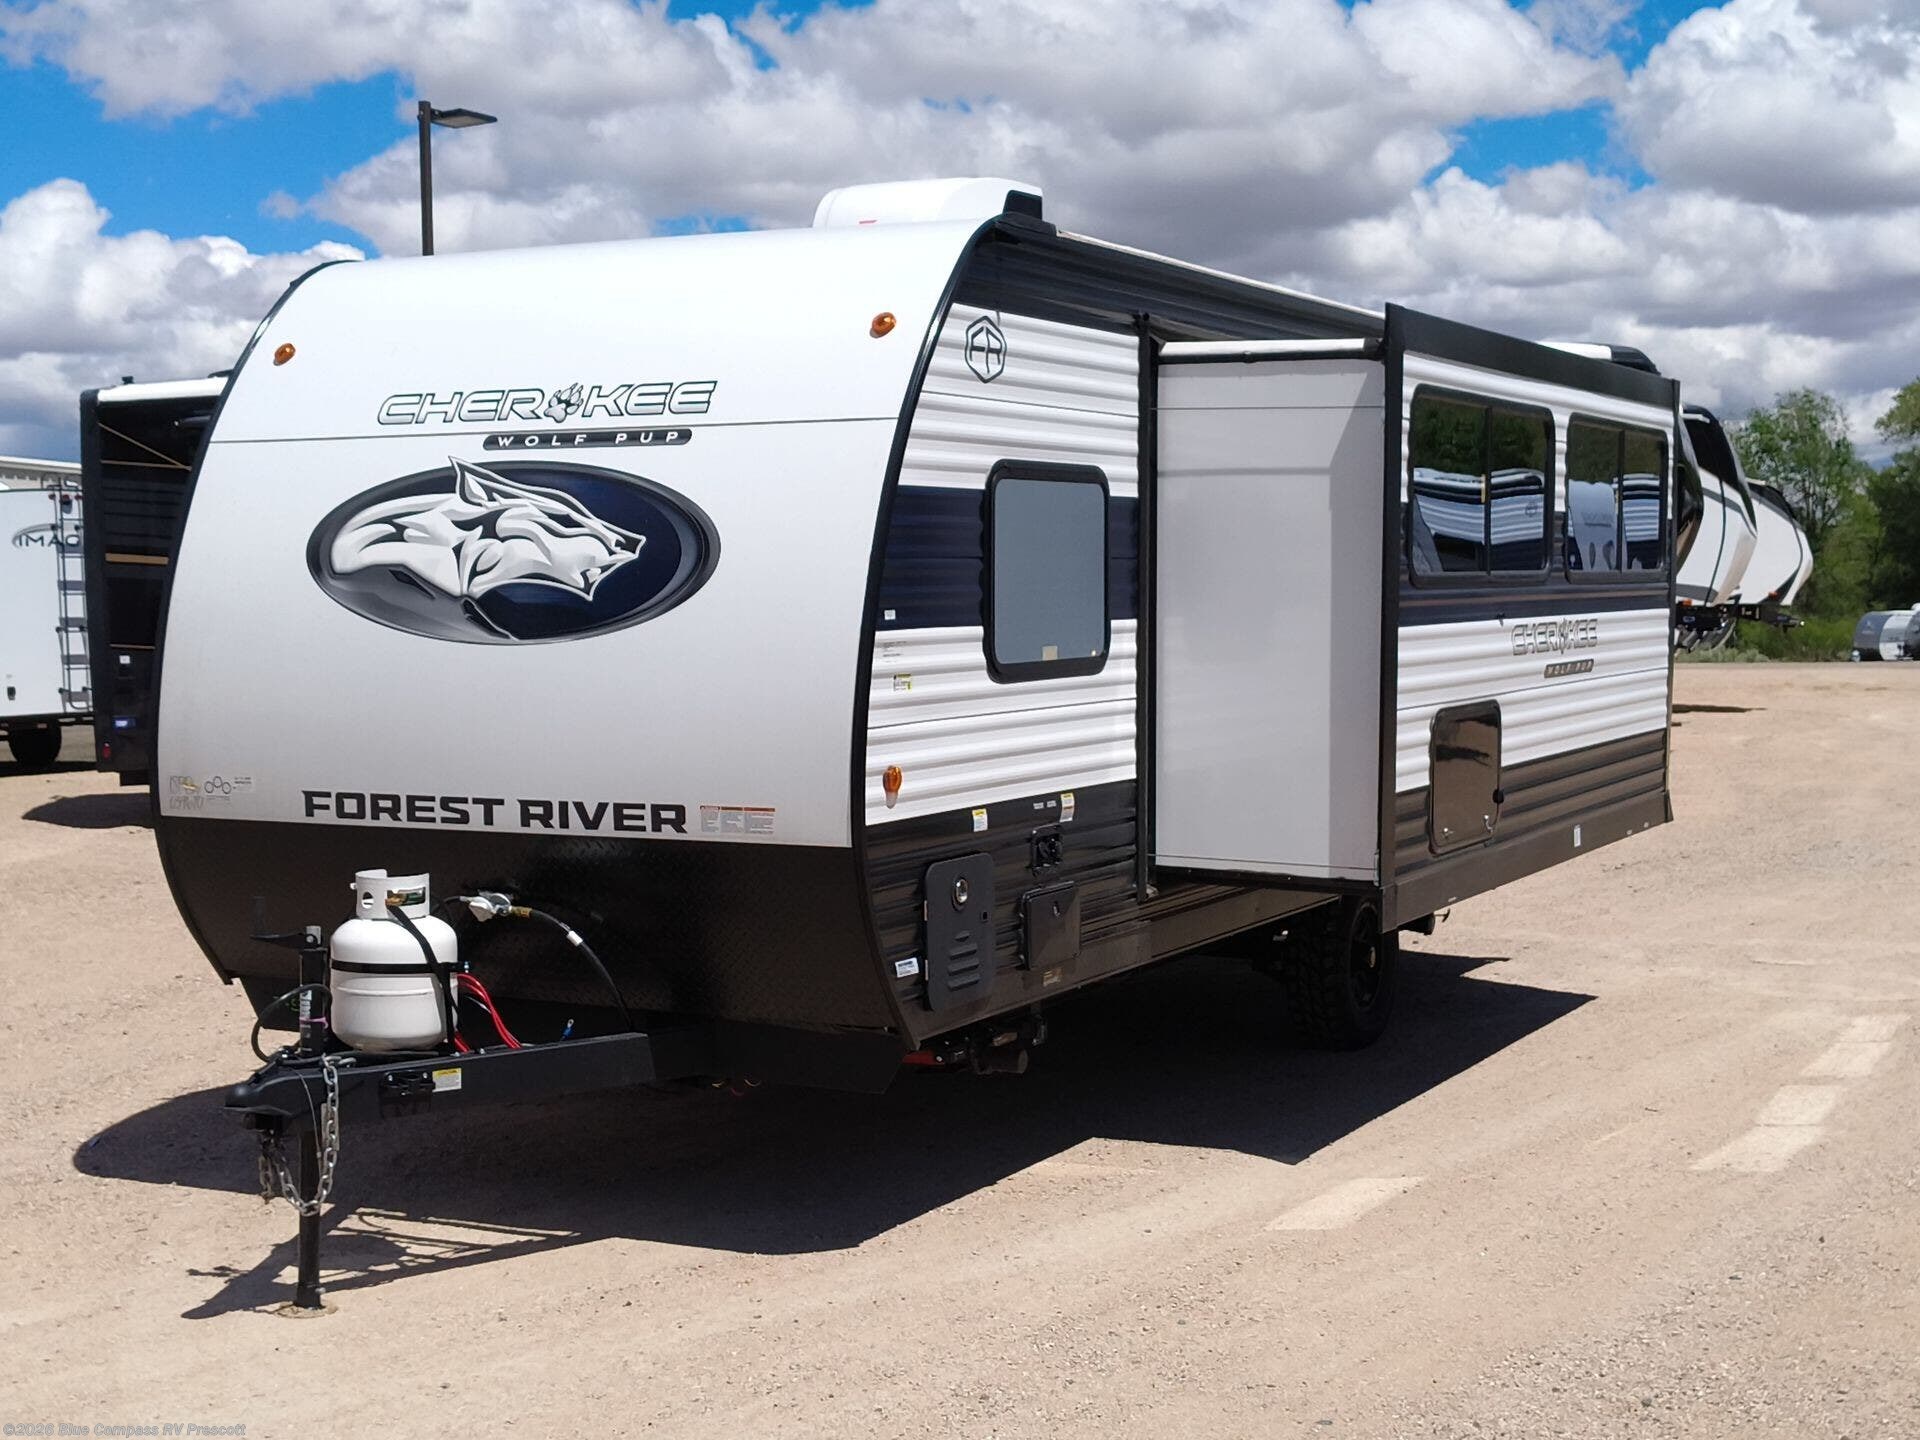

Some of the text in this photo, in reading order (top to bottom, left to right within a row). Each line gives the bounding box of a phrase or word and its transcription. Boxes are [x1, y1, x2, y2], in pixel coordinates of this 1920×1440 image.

[498, 431, 679, 448] WOLF PUP
[301, 790, 505, 825] FOREST
[517, 799, 688, 834] RIVER
